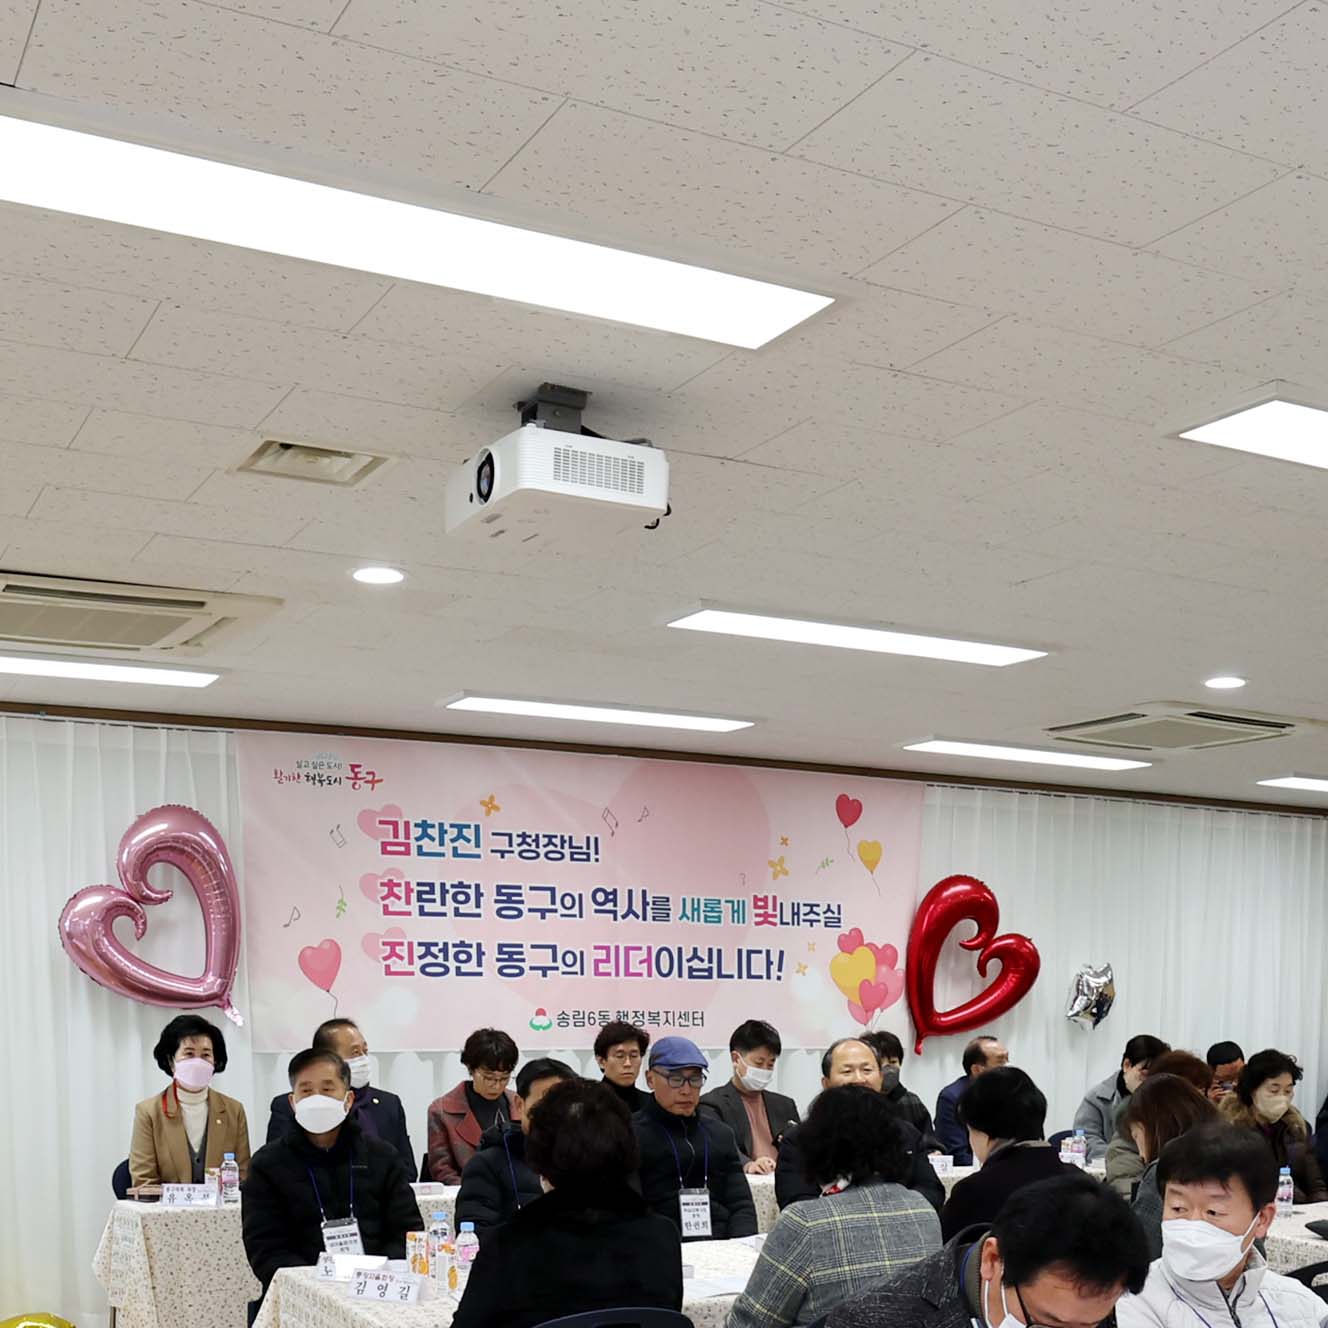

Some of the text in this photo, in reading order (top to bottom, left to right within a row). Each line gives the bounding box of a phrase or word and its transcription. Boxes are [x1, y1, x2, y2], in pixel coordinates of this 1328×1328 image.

[345, 763, 384, 791] 동구
[378, 819, 600, 863] 김찬진 구청장님!
[379, 878, 842, 928] 찬란한 동구의 역사를 새롭게 빛내주실
[381, 940, 785, 982] 진정한 동구의 리더이십니다!
[557, 1009, 705, 1028] 송림6동 행정복지센터
